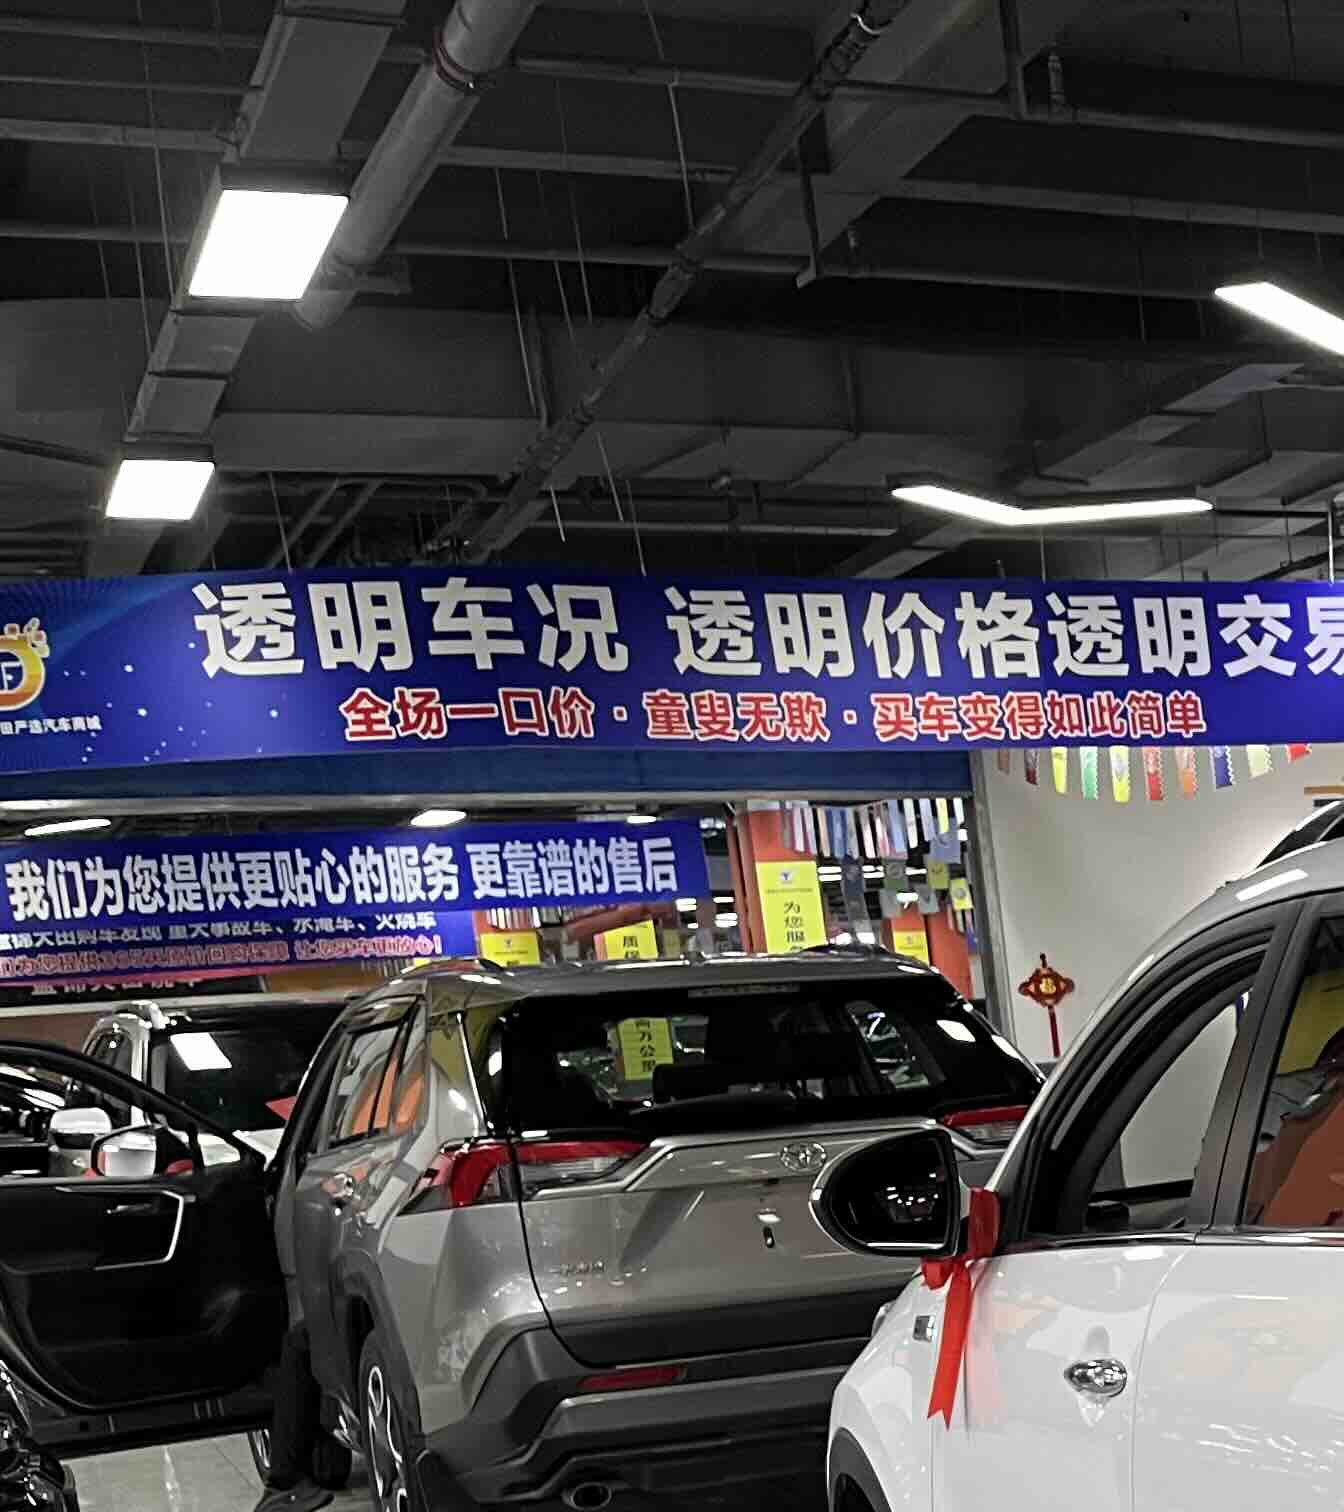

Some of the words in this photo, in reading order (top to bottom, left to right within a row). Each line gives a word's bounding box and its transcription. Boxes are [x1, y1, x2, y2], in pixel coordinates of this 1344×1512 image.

[191, 577, 629, 678] 透明车况
[6, 844, 460, 921] 我们为您提供更贴心的服务
[466, 837, 678, 900] 更靠谱的售后
[783, 901, 806, 950] 为您服
